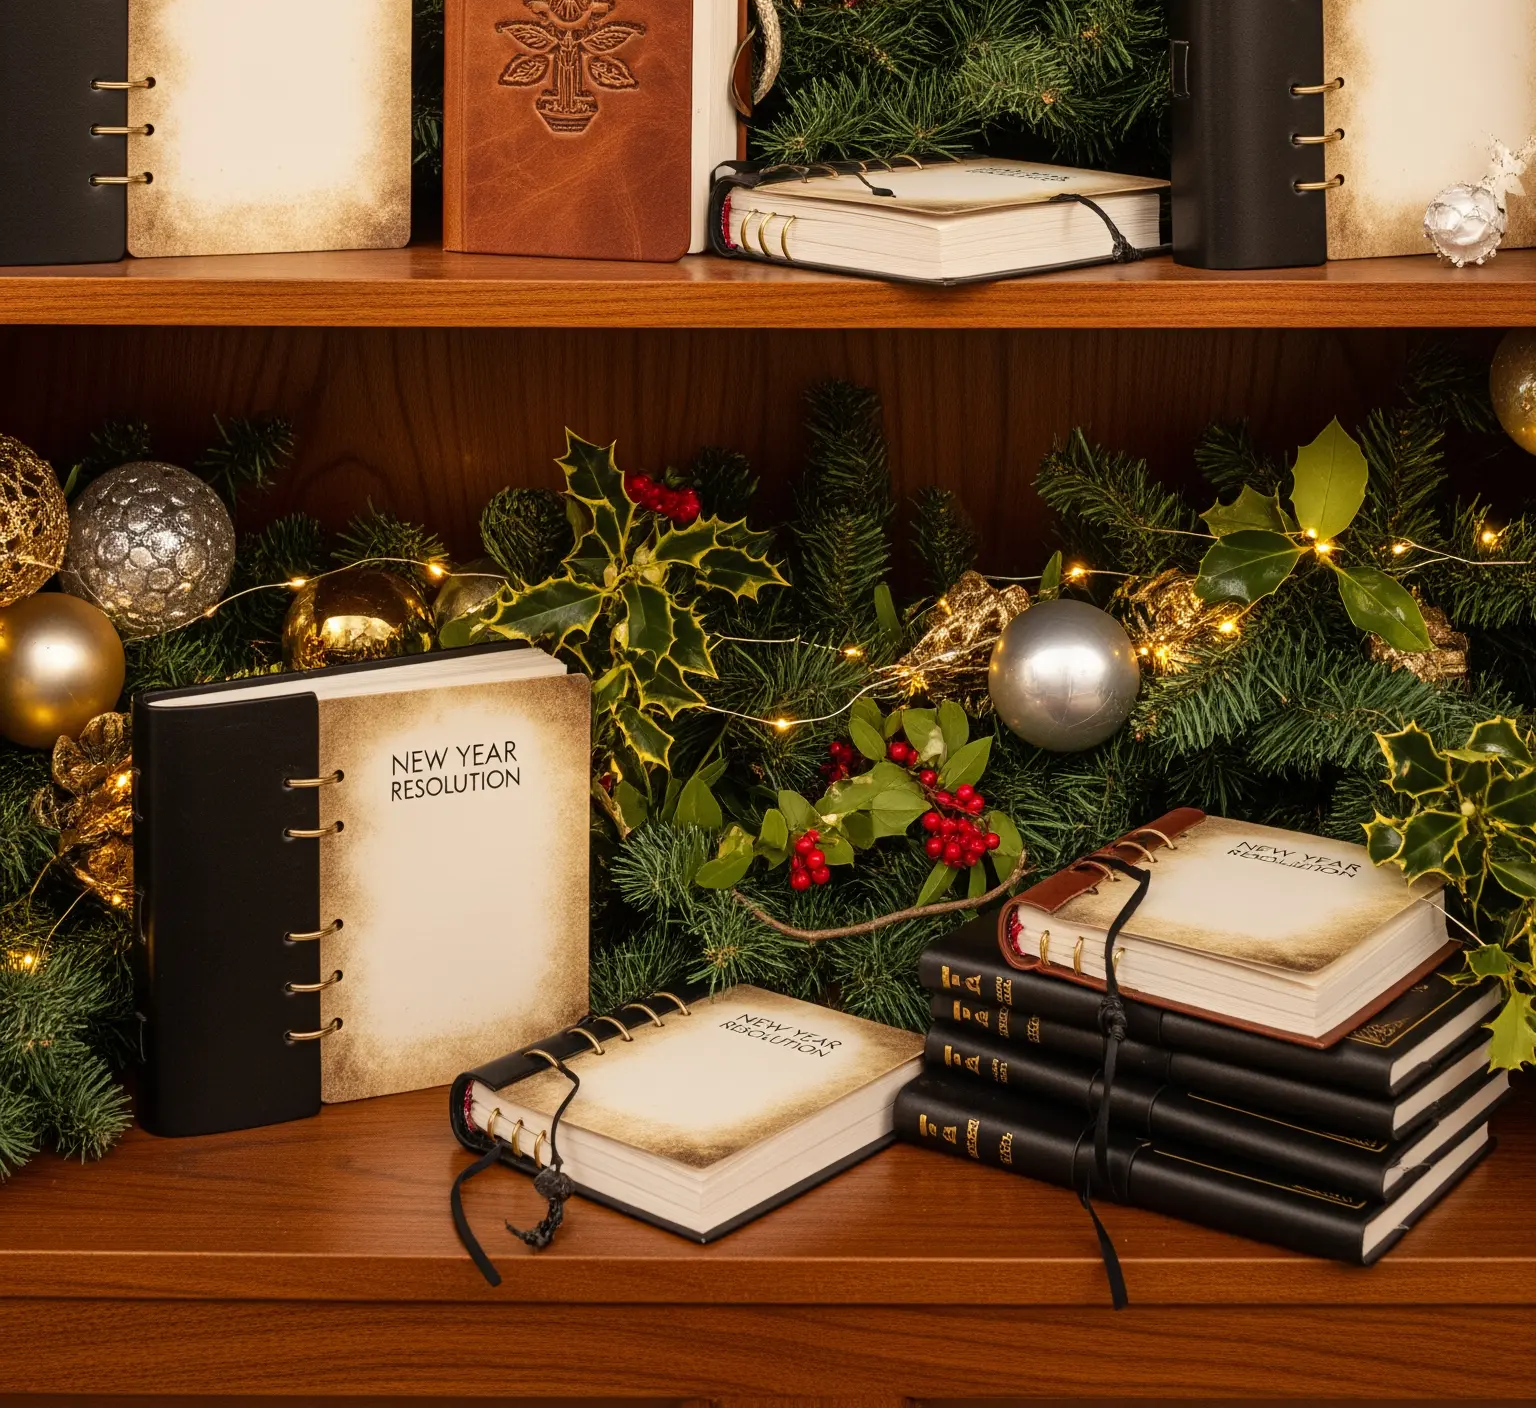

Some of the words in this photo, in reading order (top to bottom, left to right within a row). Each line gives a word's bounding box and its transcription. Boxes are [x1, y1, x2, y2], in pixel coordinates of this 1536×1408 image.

[392, 746, 449, 776] NEW
[455, 740, 518, 767] YEAR
[391, 766, 520, 802] RESOLUTION
[1236, 841, 1297, 857] NEW
[1303, 853, 1362, 873] YEAR
[735, 1013, 793, 1032] NEW
[793, 1028, 843, 1050] YEAR
